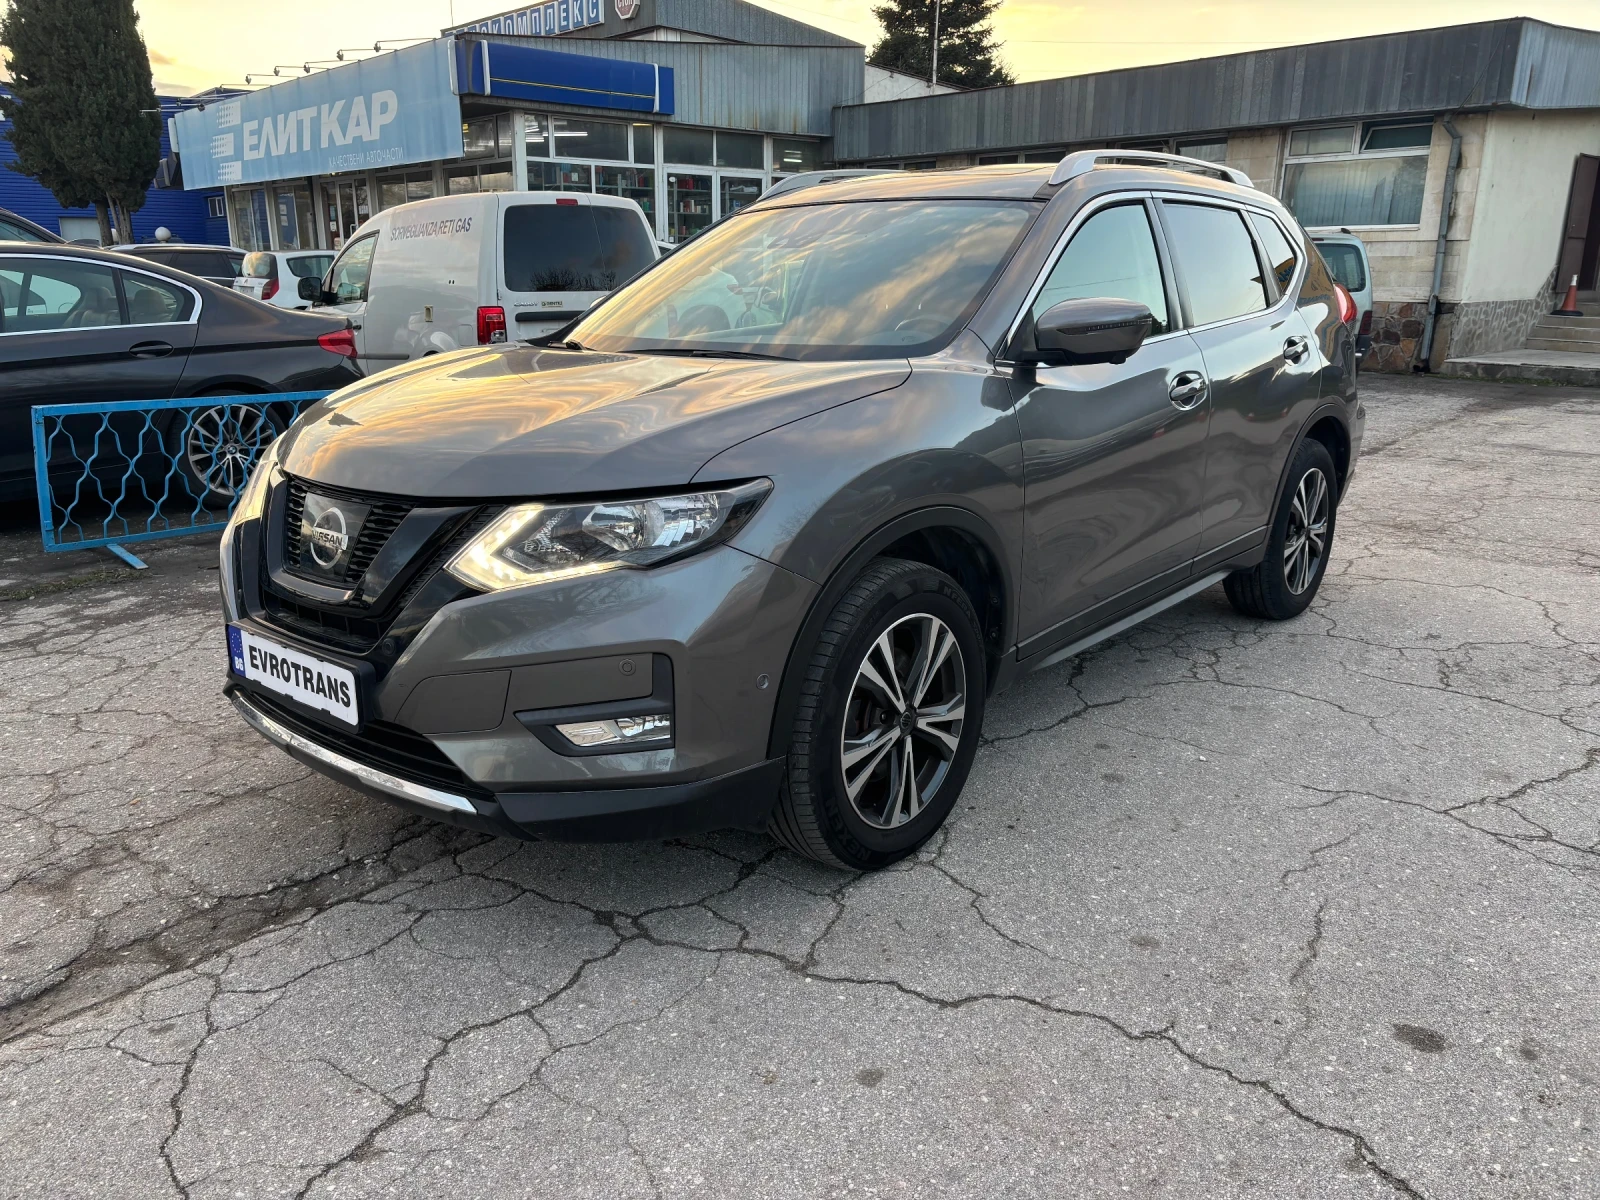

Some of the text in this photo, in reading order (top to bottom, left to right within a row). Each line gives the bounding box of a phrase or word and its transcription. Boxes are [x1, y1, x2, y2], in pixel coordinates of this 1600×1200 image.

[328, 147, 404, 168] КАЧЕСТВЕНИ АВТОЧАСТИ
[438, 219, 456, 236] RETI
[455, 217, 473, 233] GAS
[312, 529, 343, 547] NISSAN
[248, 644, 351, 708] EVROTRANS
